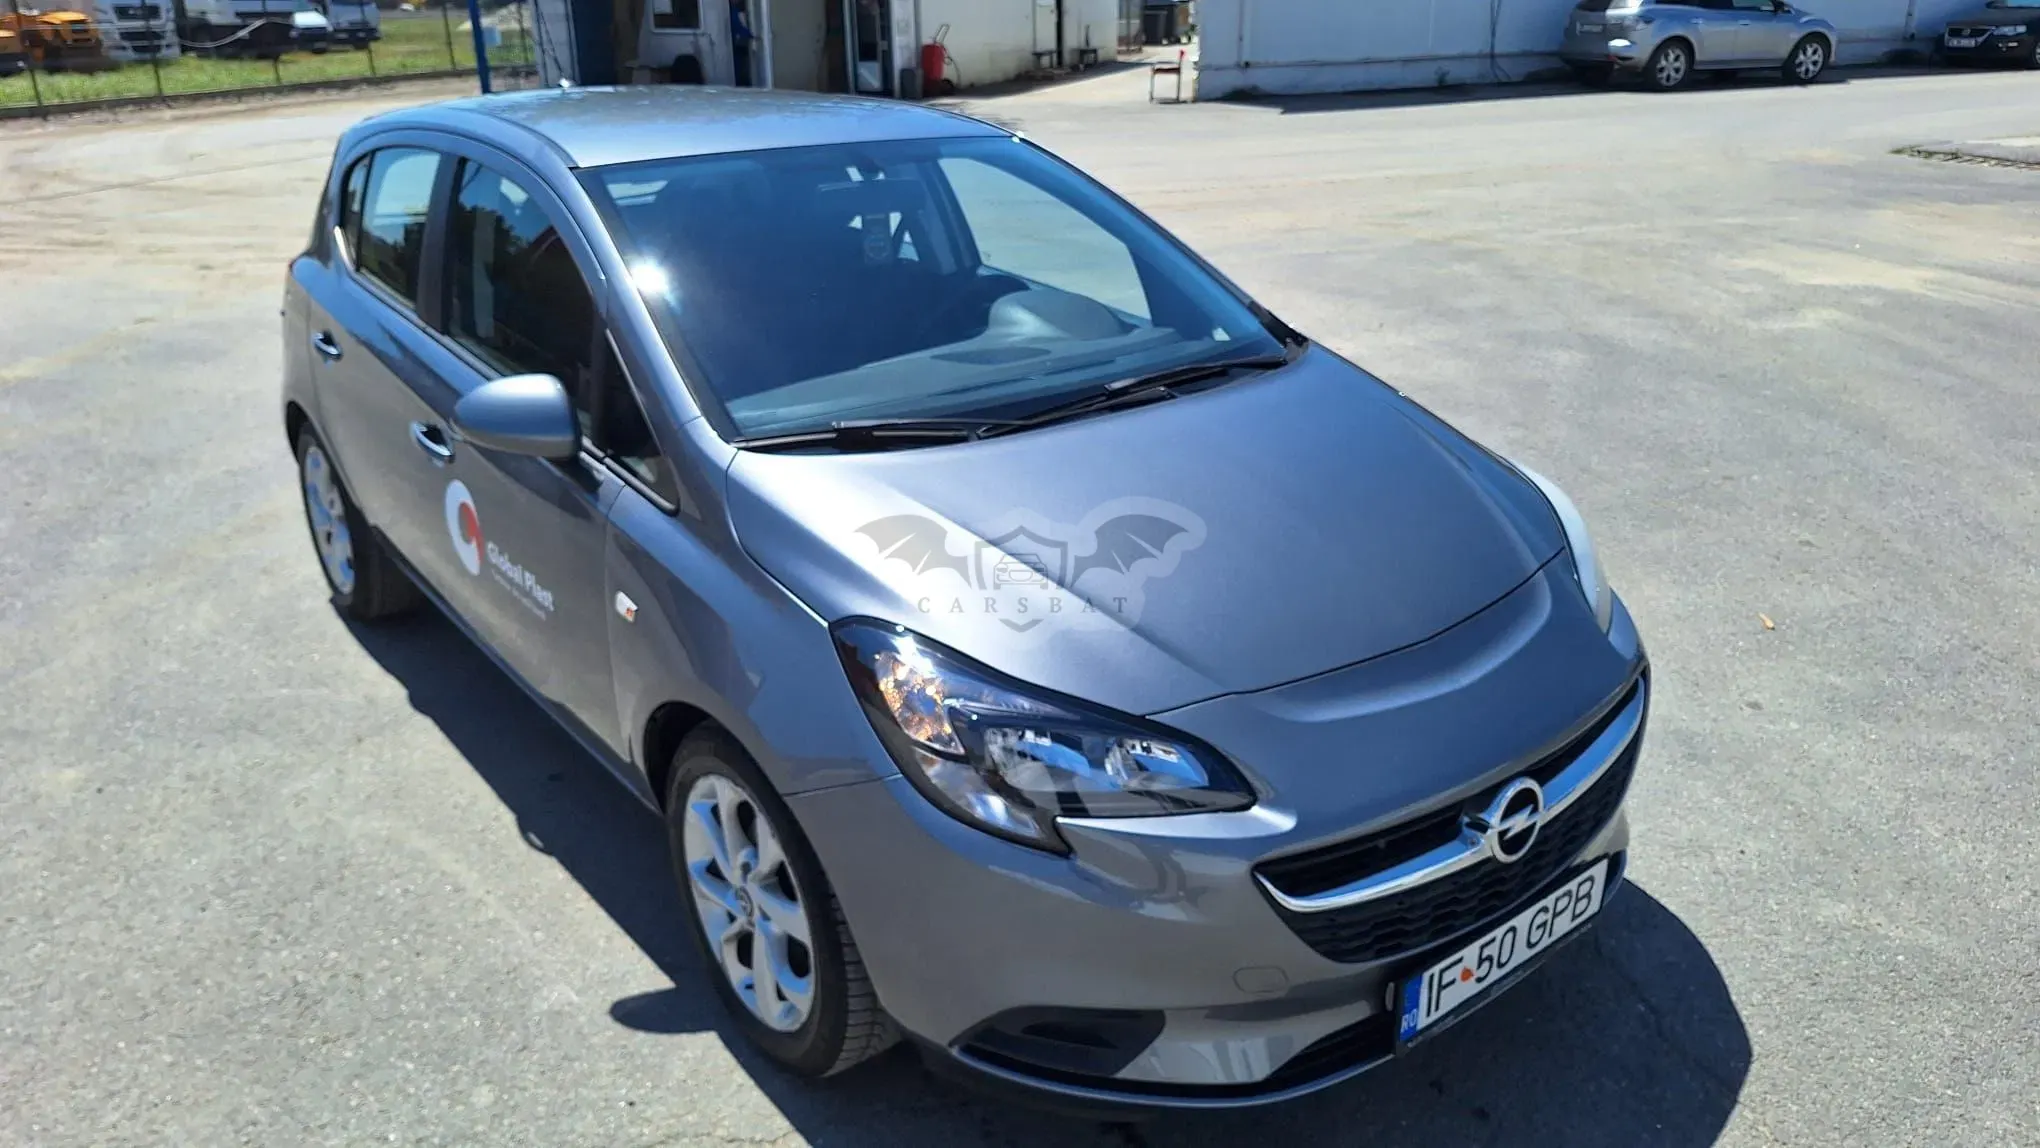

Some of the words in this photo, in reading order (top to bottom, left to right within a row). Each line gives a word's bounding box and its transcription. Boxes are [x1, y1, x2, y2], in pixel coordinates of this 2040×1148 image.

[487, 540, 524, 587] Global
[1425, 955, 1465, 1019] IF
[1474, 924, 1518, 985] 50
[1525, 874, 1596, 950] GPB
[1400, 1008, 1418, 1034] RO
